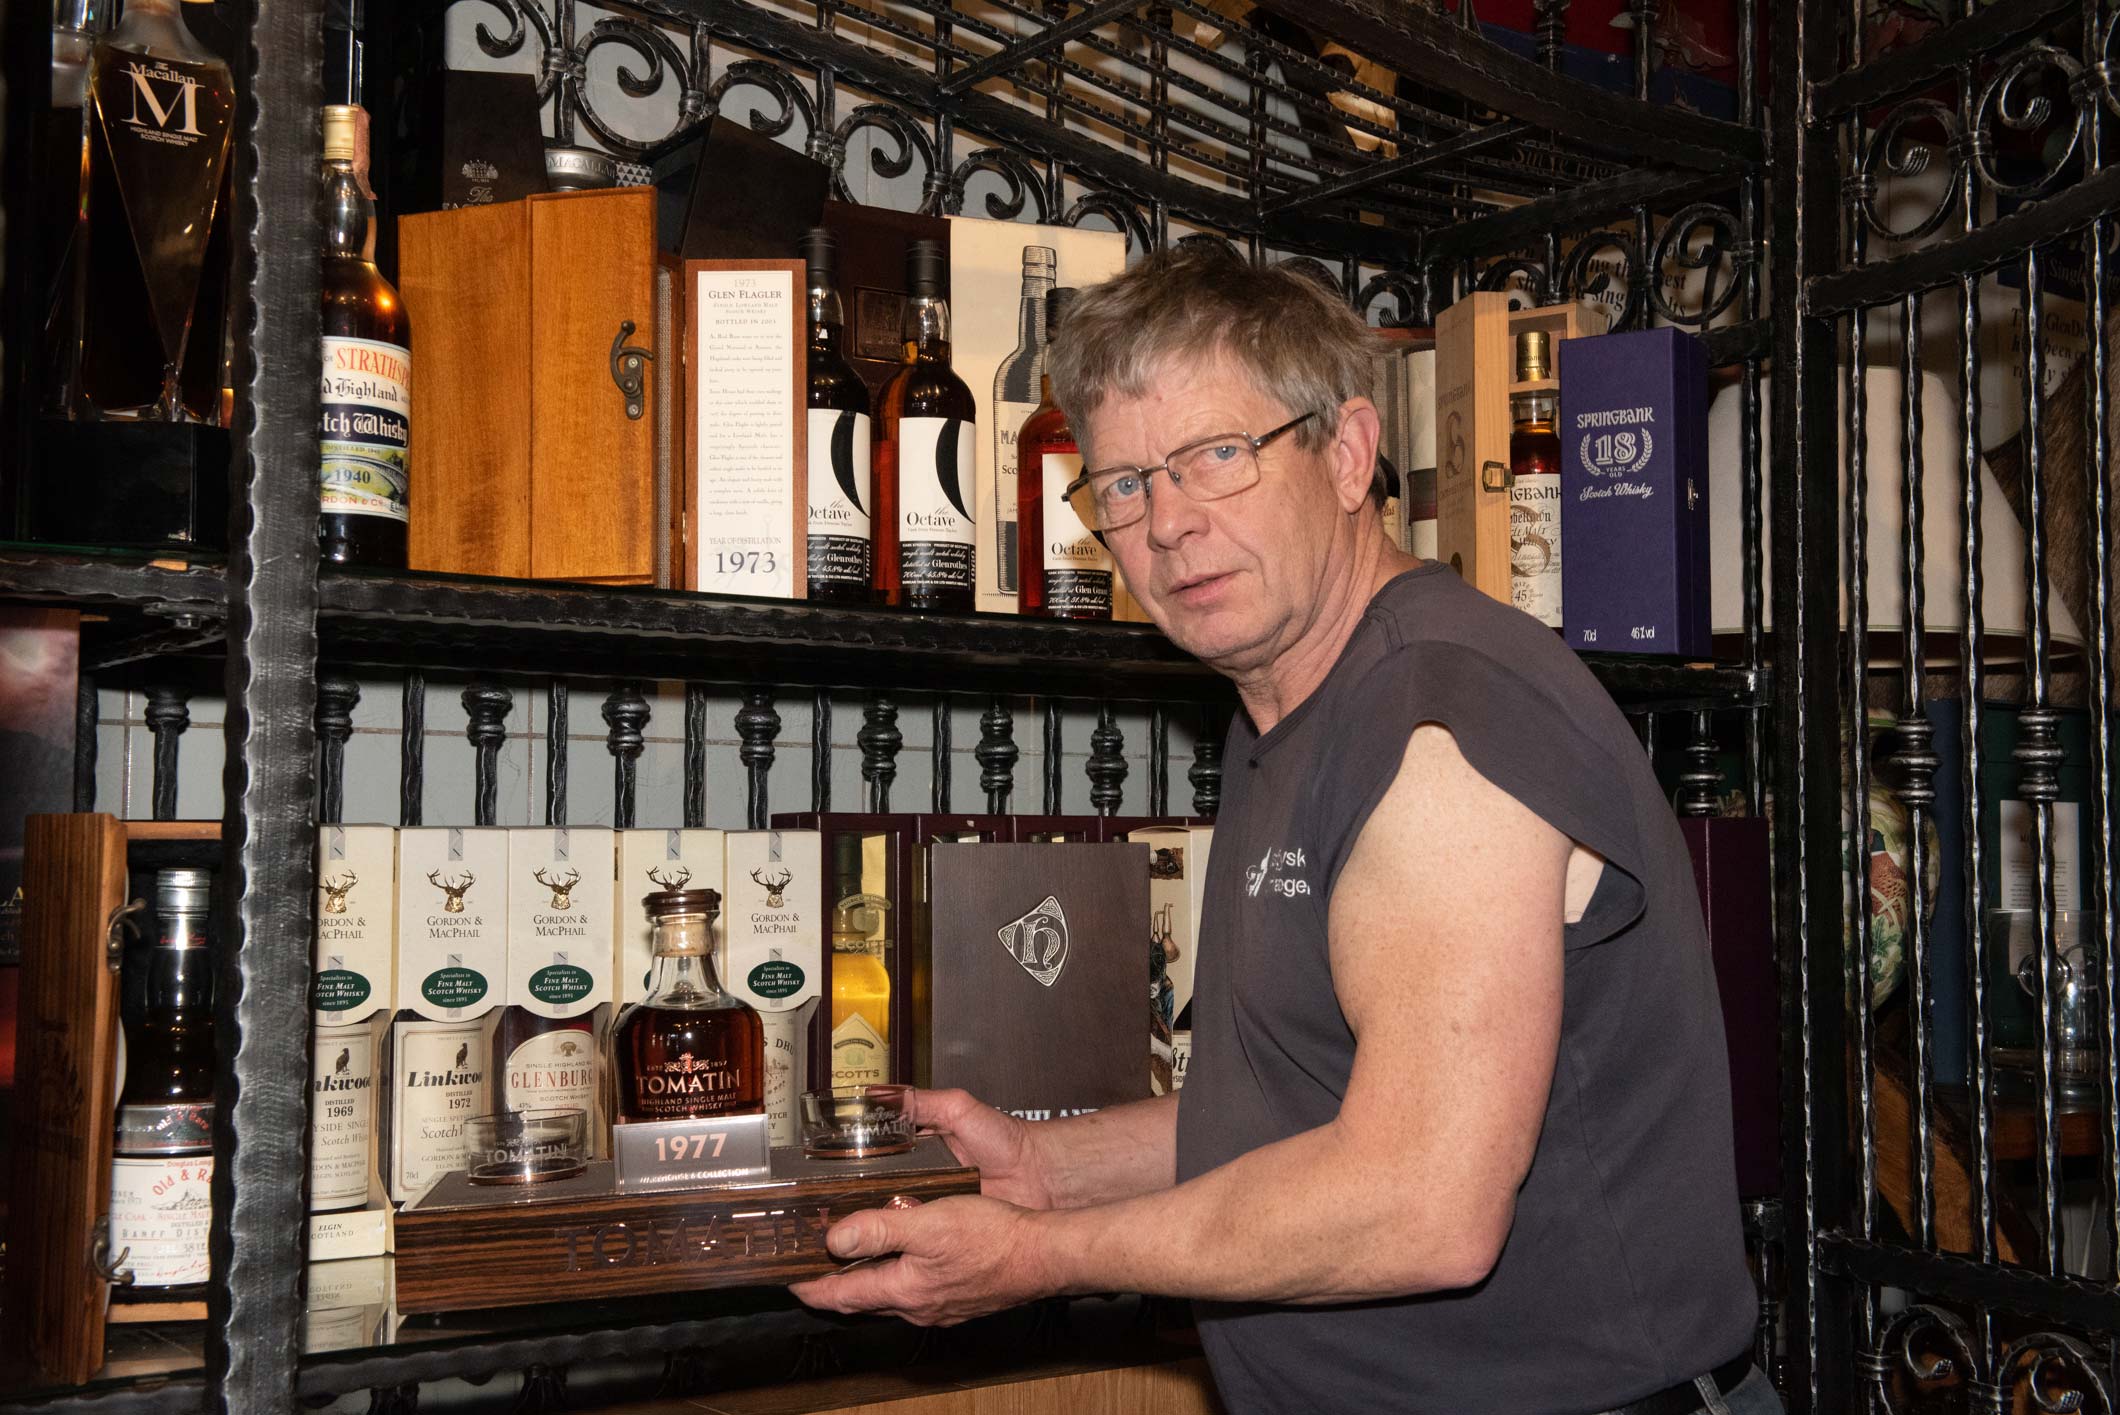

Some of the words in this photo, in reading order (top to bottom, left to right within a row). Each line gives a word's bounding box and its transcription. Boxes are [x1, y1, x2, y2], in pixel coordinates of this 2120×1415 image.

[128, 61, 197, 85] Macallan
[120, 69, 207, 136] M
[467, 186, 493, 202] The
[2050, 257, 2083, 288] Singl
[708, 289, 736, 300] GLEN
[739, 289, 783, 300] FLAGLER
[336, 347, 409, 392] STRATHSP
[335, 377, 398, 402] Highland
[1577, 406, 1655, 429] SPRINGBANK
[323, 411, 351, 438] tch
[1595, 432, 1637, 465] 18
[335, 469, 371, 484] 1940
[1580, 485, 1613, 501] Scotch
[1613, 482, 1654, 499] Whisky
[323, 495, 357, 505] RDON
[906, 511, 956, 527] Octave
[709, 537, 727, 545] YEAR
[727, 537, 737, 545] OF
[737, 537, 782, 545] DISTILLATION
[1051, 542, 1097, 556] Octave
[716, 552, 776, 574] 1973
[826, 553, 863, 564] Glenrothes
[931, 560, 968, 569] Glenrothes
[1075, 585, 1092, 594] Glen
[1583, 628, 1597, 642] 70cl
[317, 917, 354, 926] ORDON
[357, 917, 366, 926] &
[427, 916, 472, 926] GORDON
[474, 916, 483, 926] &
[533, 914, 577, 925] GORDON
[580, 914, 588, 924] &
[751, 912, 790, 922] GORDON
[792, 912, 800, 922] &
[317, 928, 364, 939] ACPHAIL
[335, 982, 355, 990] MALT
[437, 980, 454, 988] FINE
[455, 979, 473, 987] MALT
[534, 984, 561, 992] SCOTCH
[562, 983, 588, 991] WHISKY
[336, 989, 365, 997] WHISKY
[428, 987, 454, 995] SCOTCH
[456, 986, 483, 994] WHISKY
[554, 1060, 585, 1068] HIGHLAND
[314, 1075, 371, 1092] nkwoo
[407, 1070, 482, 1088] Linkwo
[511, 1069, 592, 1088] GLENBURG
[636, 1068, 740, 1095] TOMATIN
[325, 1098, 355, 1106] DISTILLED
[449, 1098, 471, 1110] 1972
[641, 1098, 683, 1106] HIGHLAND
[685, 1095, 715, 1104] SINGLE
[717, 1092, 737, 1101] MALT
[327, 1105, 354, 1118] 1969
[655, 1104, 688, 1113] SCOTCH
[687, 1103, 723, 1113] WHISKY
[996, 1107, 1100, 1121] GHLA
[313, 1122, 343, 1133] YSIDE
[347, 1120, 368, 1129] SING
[420, 1124, 458, 1139] Scotch
[321, 1134, 350, 1146] Scotch
[655, 1133, 728, 1161] 1977
[697, 1168, 750, 1179] COLLECTION
[152, 1174, 175, 1196] Old
[181, 1169, 189, 1181] &
[197, 1168, 212, 1183] Ra
[319, 1223, 342, 1232] ELGIN
[310, 1230, 354, 1240] COTLAND
[552, 1208, 831, 1273] TOMATIN
